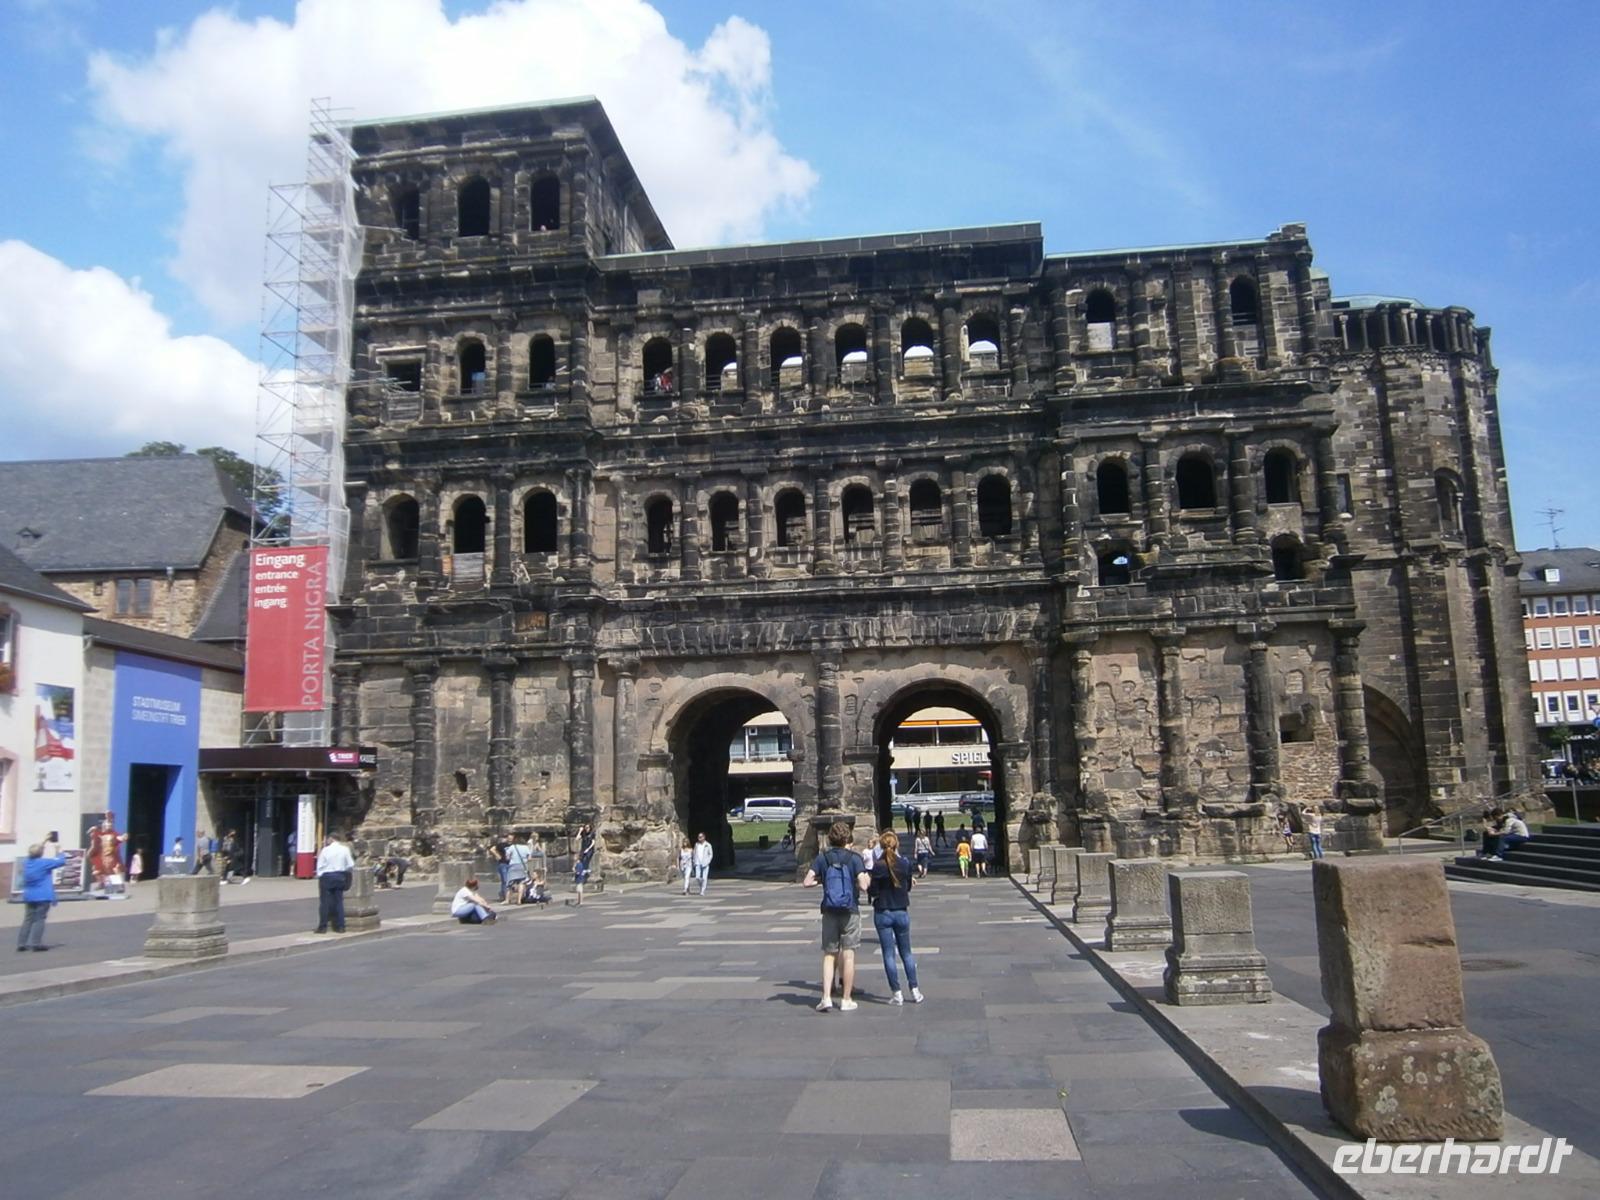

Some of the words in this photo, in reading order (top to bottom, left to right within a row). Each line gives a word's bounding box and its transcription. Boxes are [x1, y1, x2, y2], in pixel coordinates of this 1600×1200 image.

[255, 553, 306, 569] Eingang
[255, 571, 299, 580] entrance
[255, 583, 287, 594] entrée
[304, 561, 322, 630] NIGRA
[254, 597, 288, 608] ingang
[301, 637, 321, 706] PORTA
